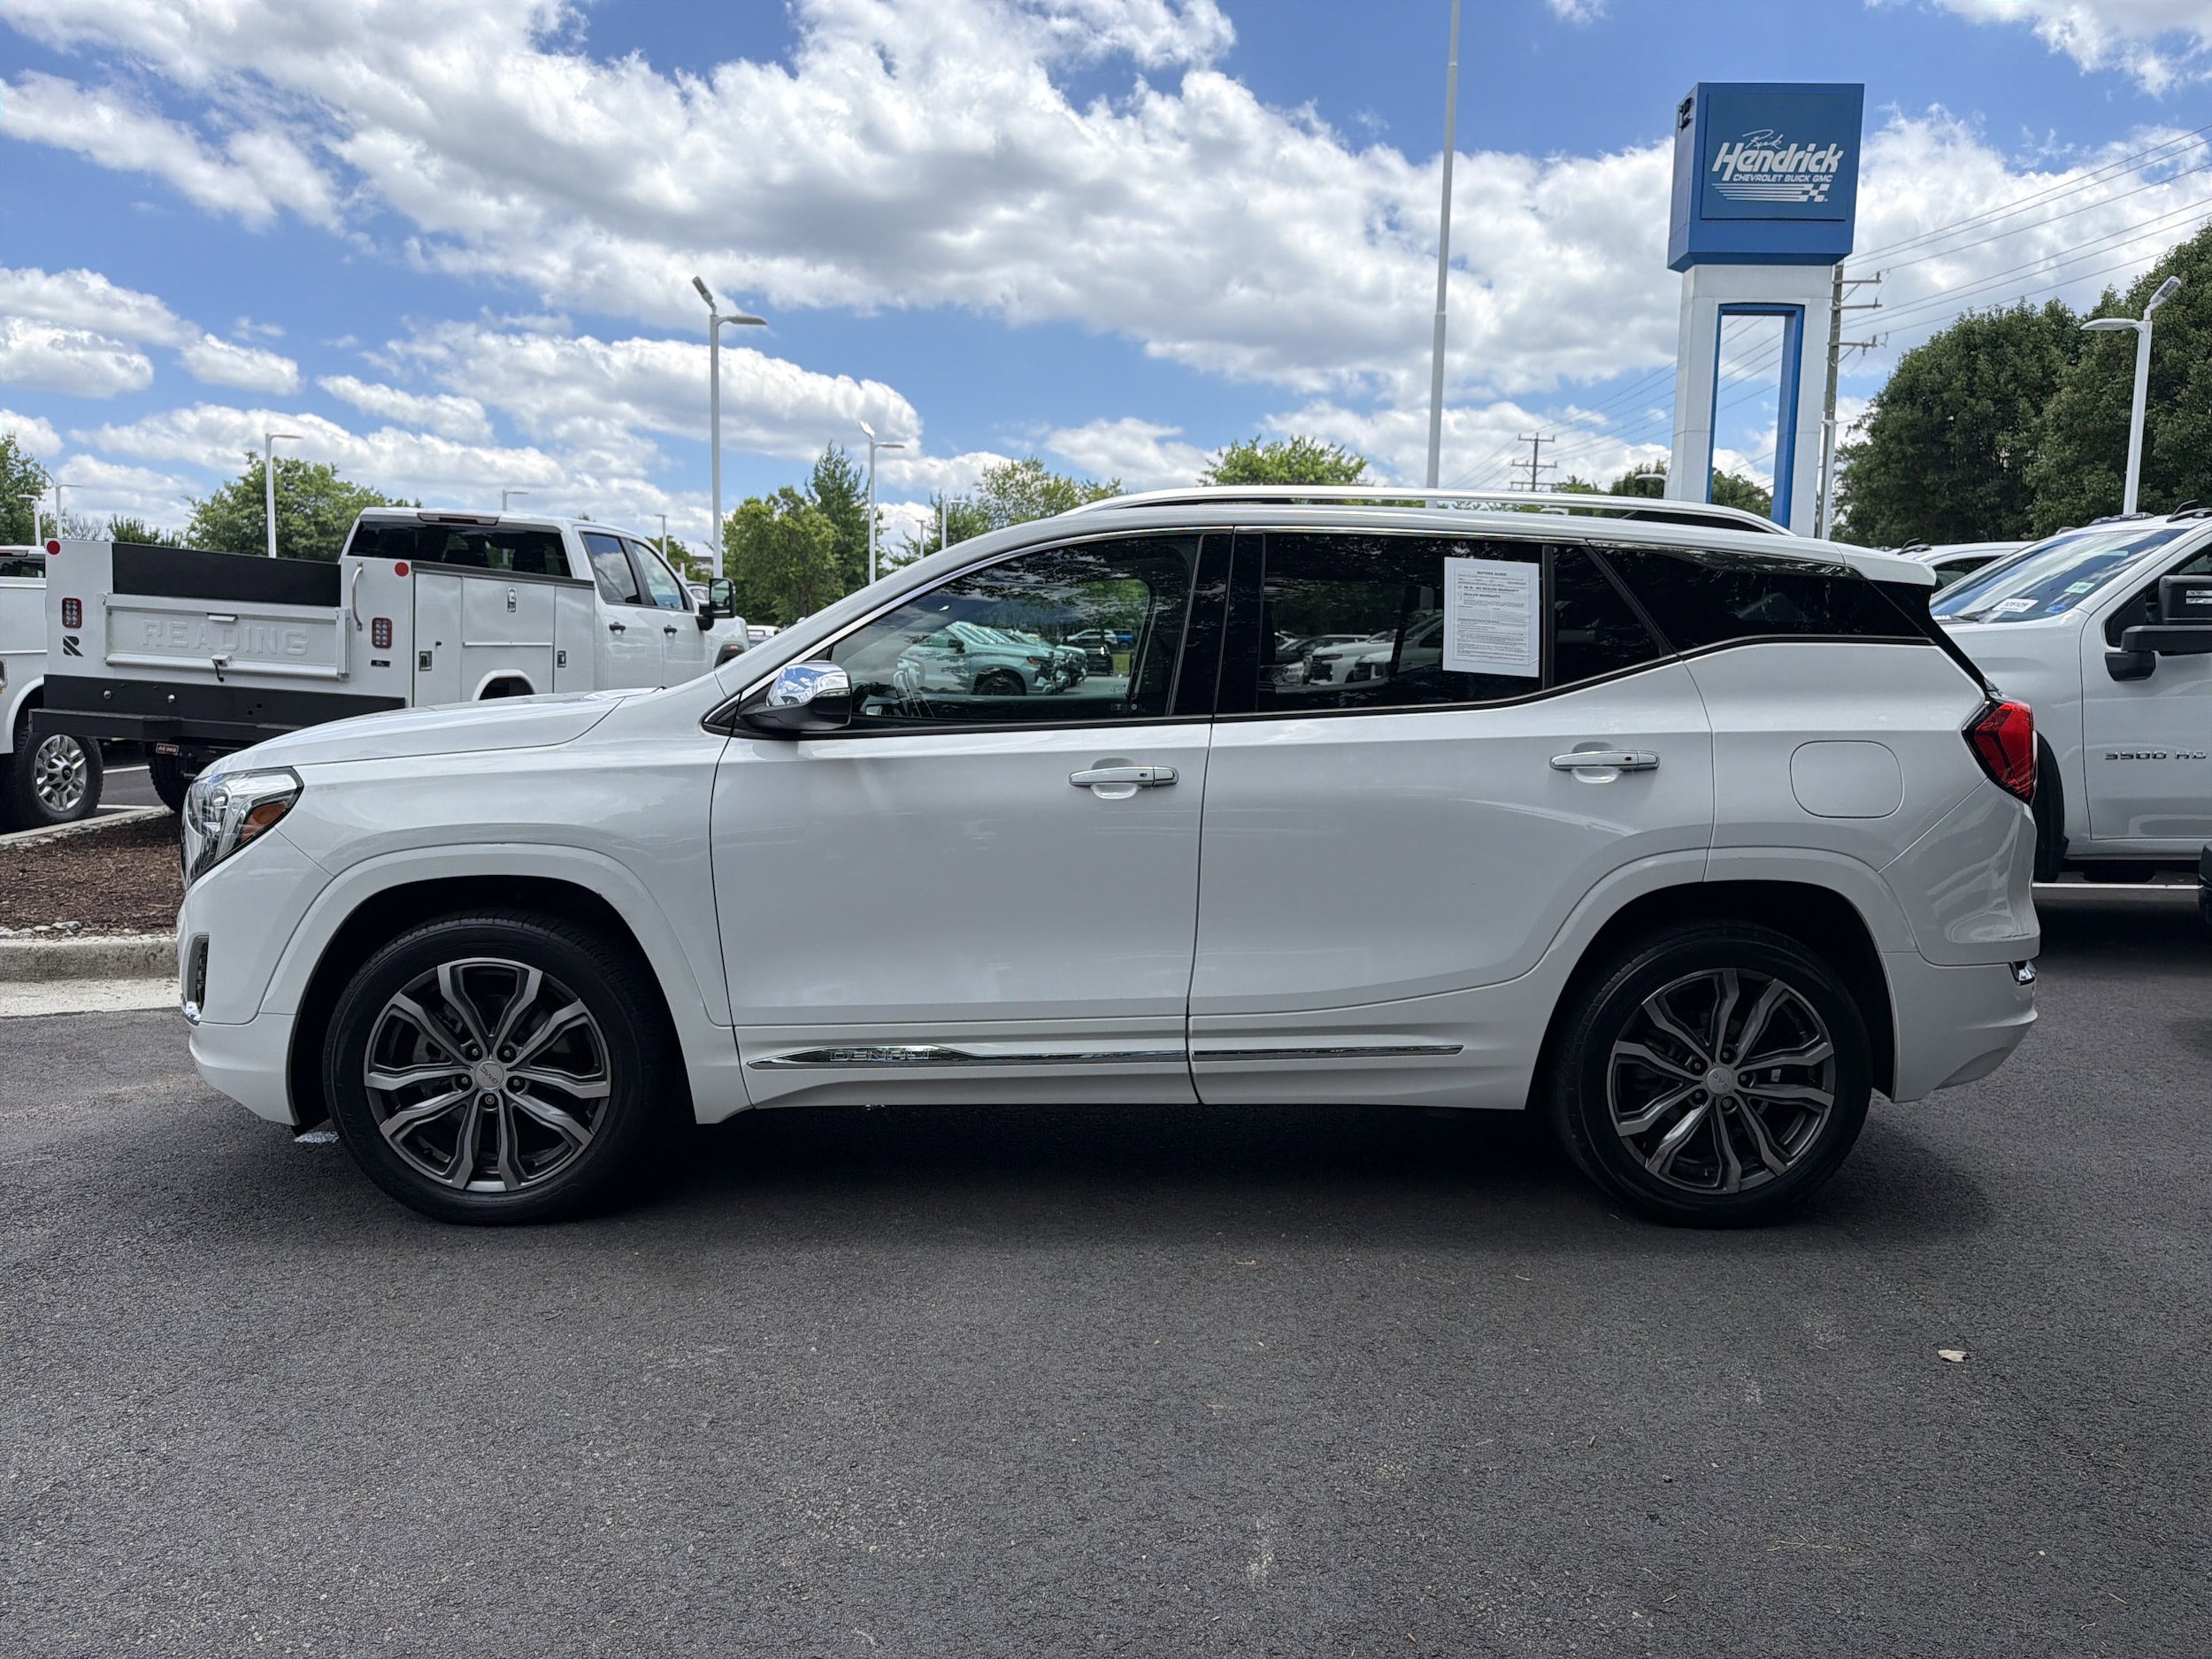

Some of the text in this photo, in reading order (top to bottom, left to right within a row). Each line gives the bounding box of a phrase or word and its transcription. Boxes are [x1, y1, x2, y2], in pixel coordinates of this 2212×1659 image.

[1711, 142, 1844, 181] Hendrick
[1732, 173, 1782, 182] CHEVROLET
[142, 619, 309, 657] READING
[2105, 750, 2207, 760] 3500 HD
[830, 1048, 930, 1061] DENALI
[480, 1065, 498, 1085] GMC
